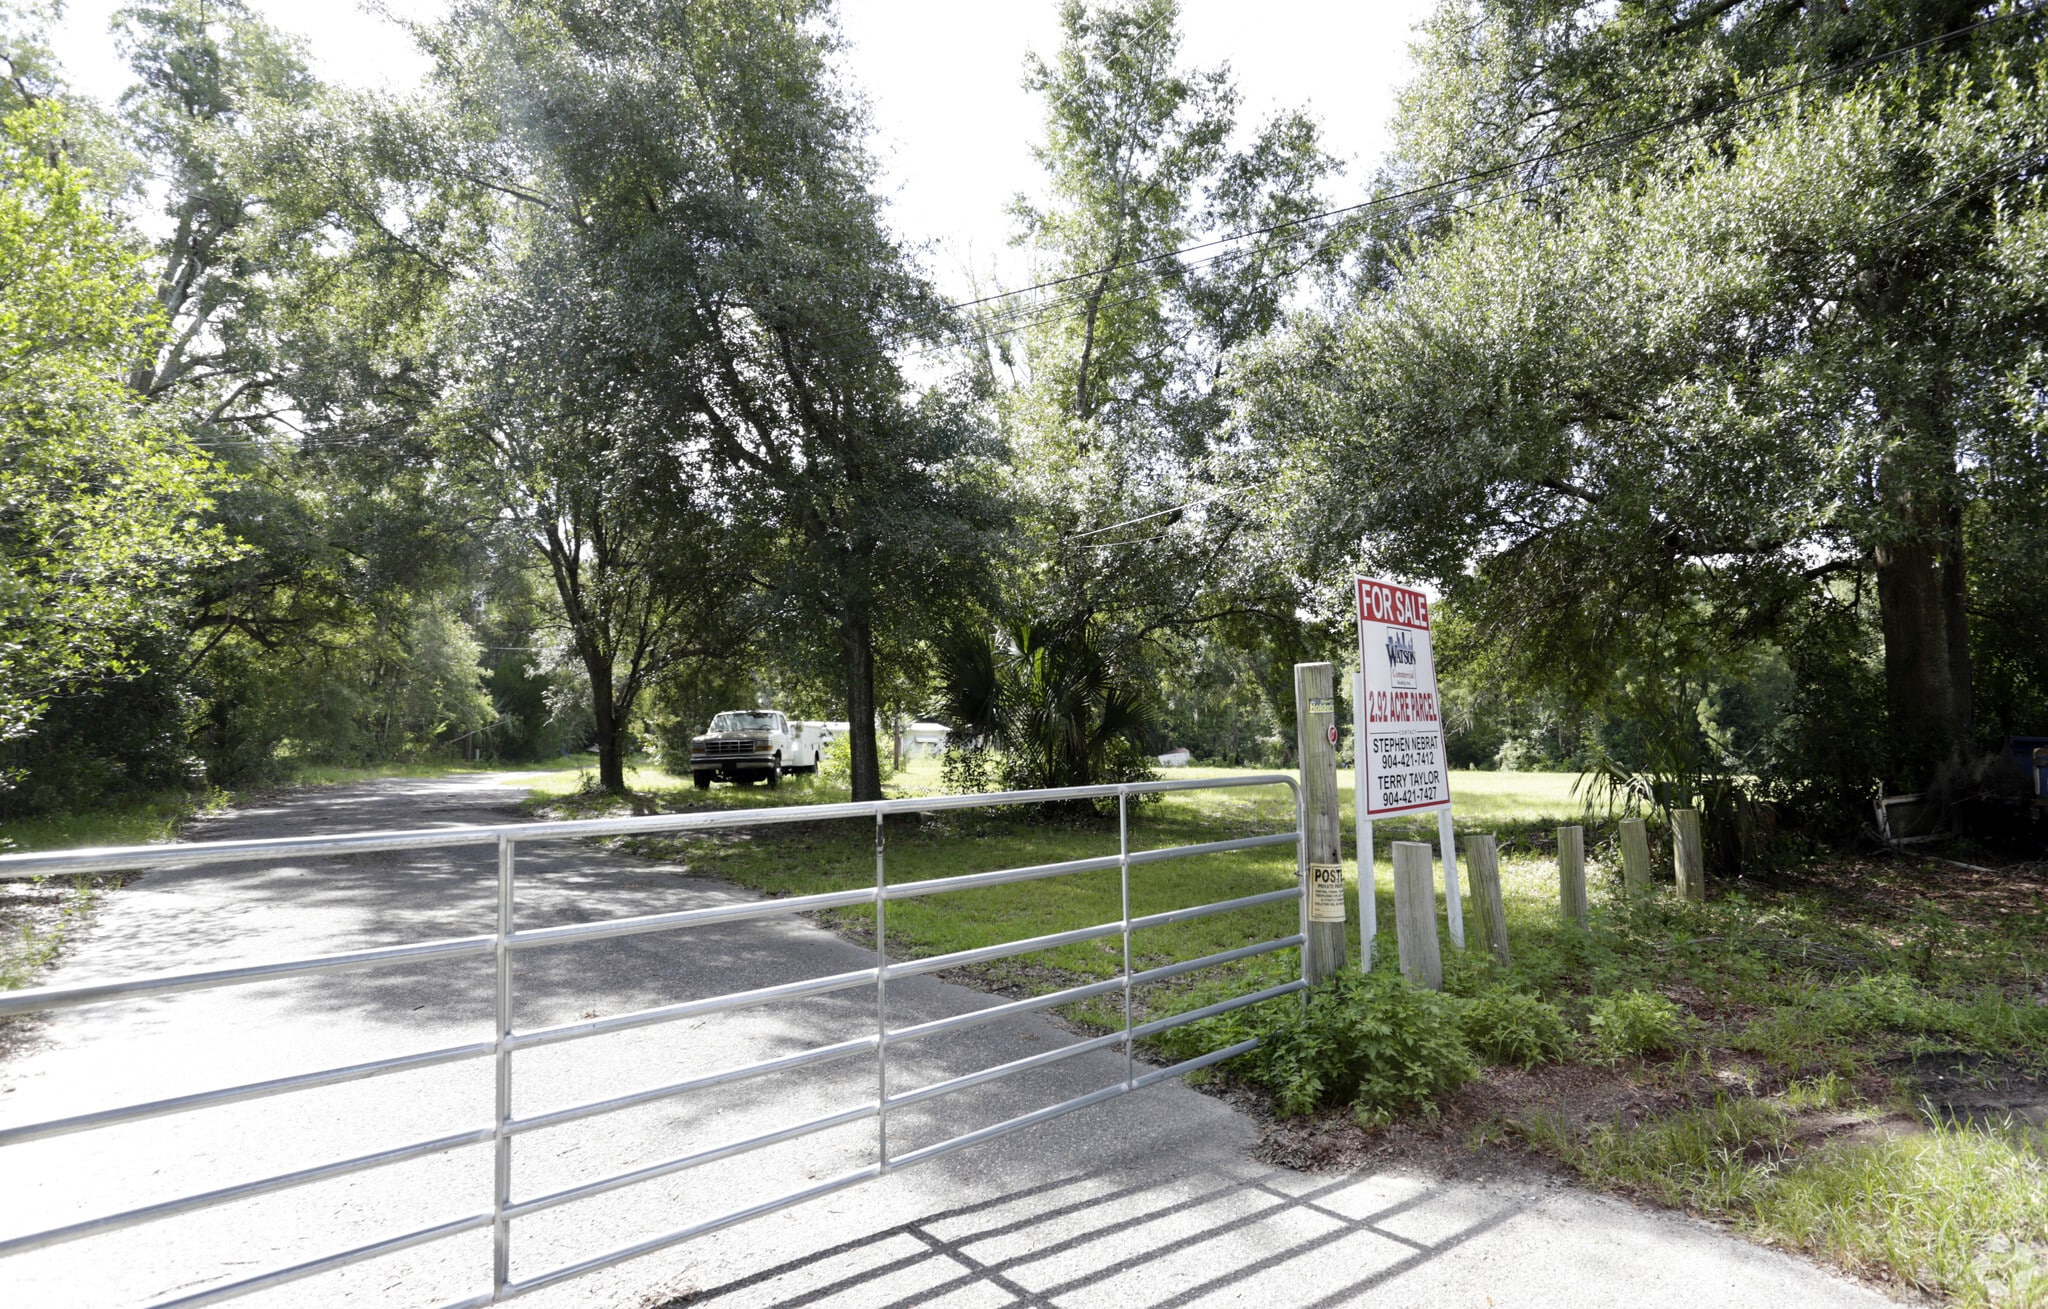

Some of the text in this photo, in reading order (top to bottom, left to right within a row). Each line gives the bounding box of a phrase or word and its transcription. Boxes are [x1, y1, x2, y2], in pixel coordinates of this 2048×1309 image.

[1362, 583, 1428, 627] FOR SALE
[1385, 643, 1416, 668] WATSON
[1369, 691, 1437, 722] 2.92 ACRE PARCEL
[1373, 736, 1438, 753] STEPHEN NEBRAT
[1382, 752, 1434, 769] 904-421-7412
[1377, 771, 1440, 790] TERRY TAYLOR
[1383, 787, 1437, 806] 904-421-7427
